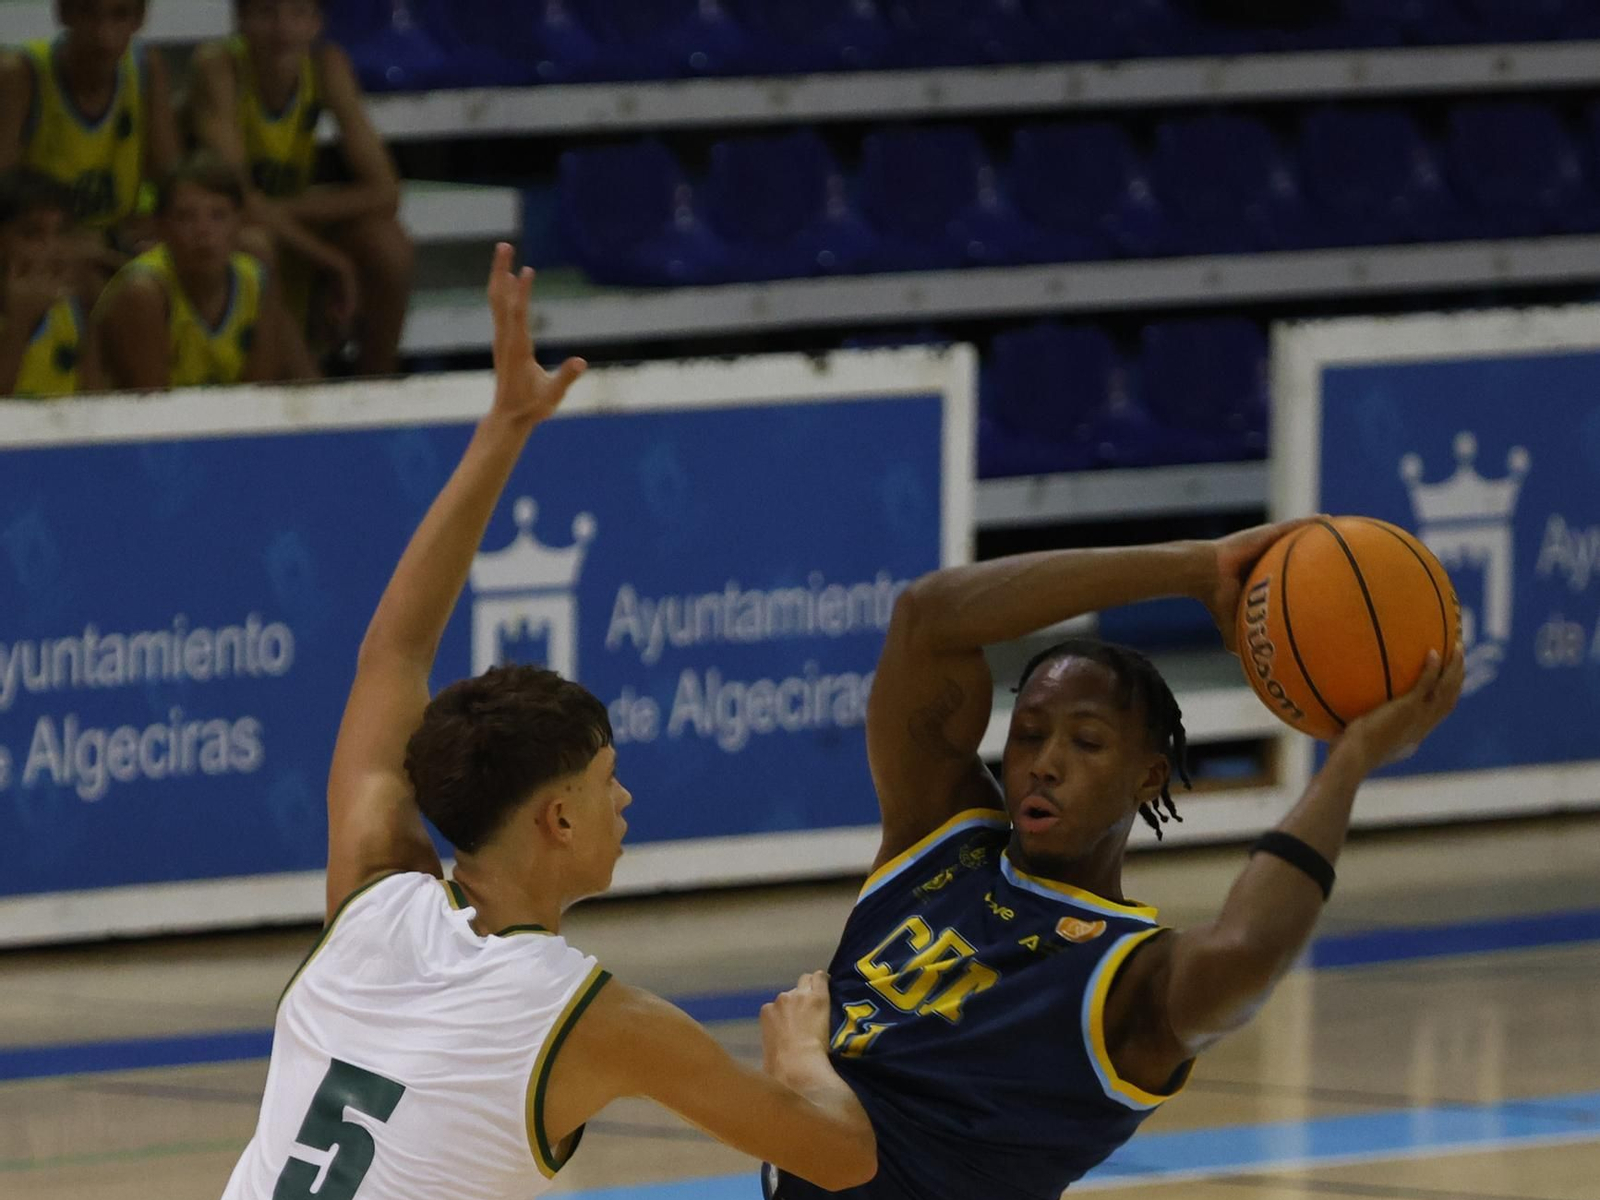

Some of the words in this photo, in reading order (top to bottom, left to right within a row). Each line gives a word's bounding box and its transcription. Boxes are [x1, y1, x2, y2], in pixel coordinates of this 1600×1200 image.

[605, 568, 908, 665] Ayuntamient
[21, 704, 265, 802] Algeciras
[608, 684, 660, 744] de
[667, 660, 875, 754] Algecira
